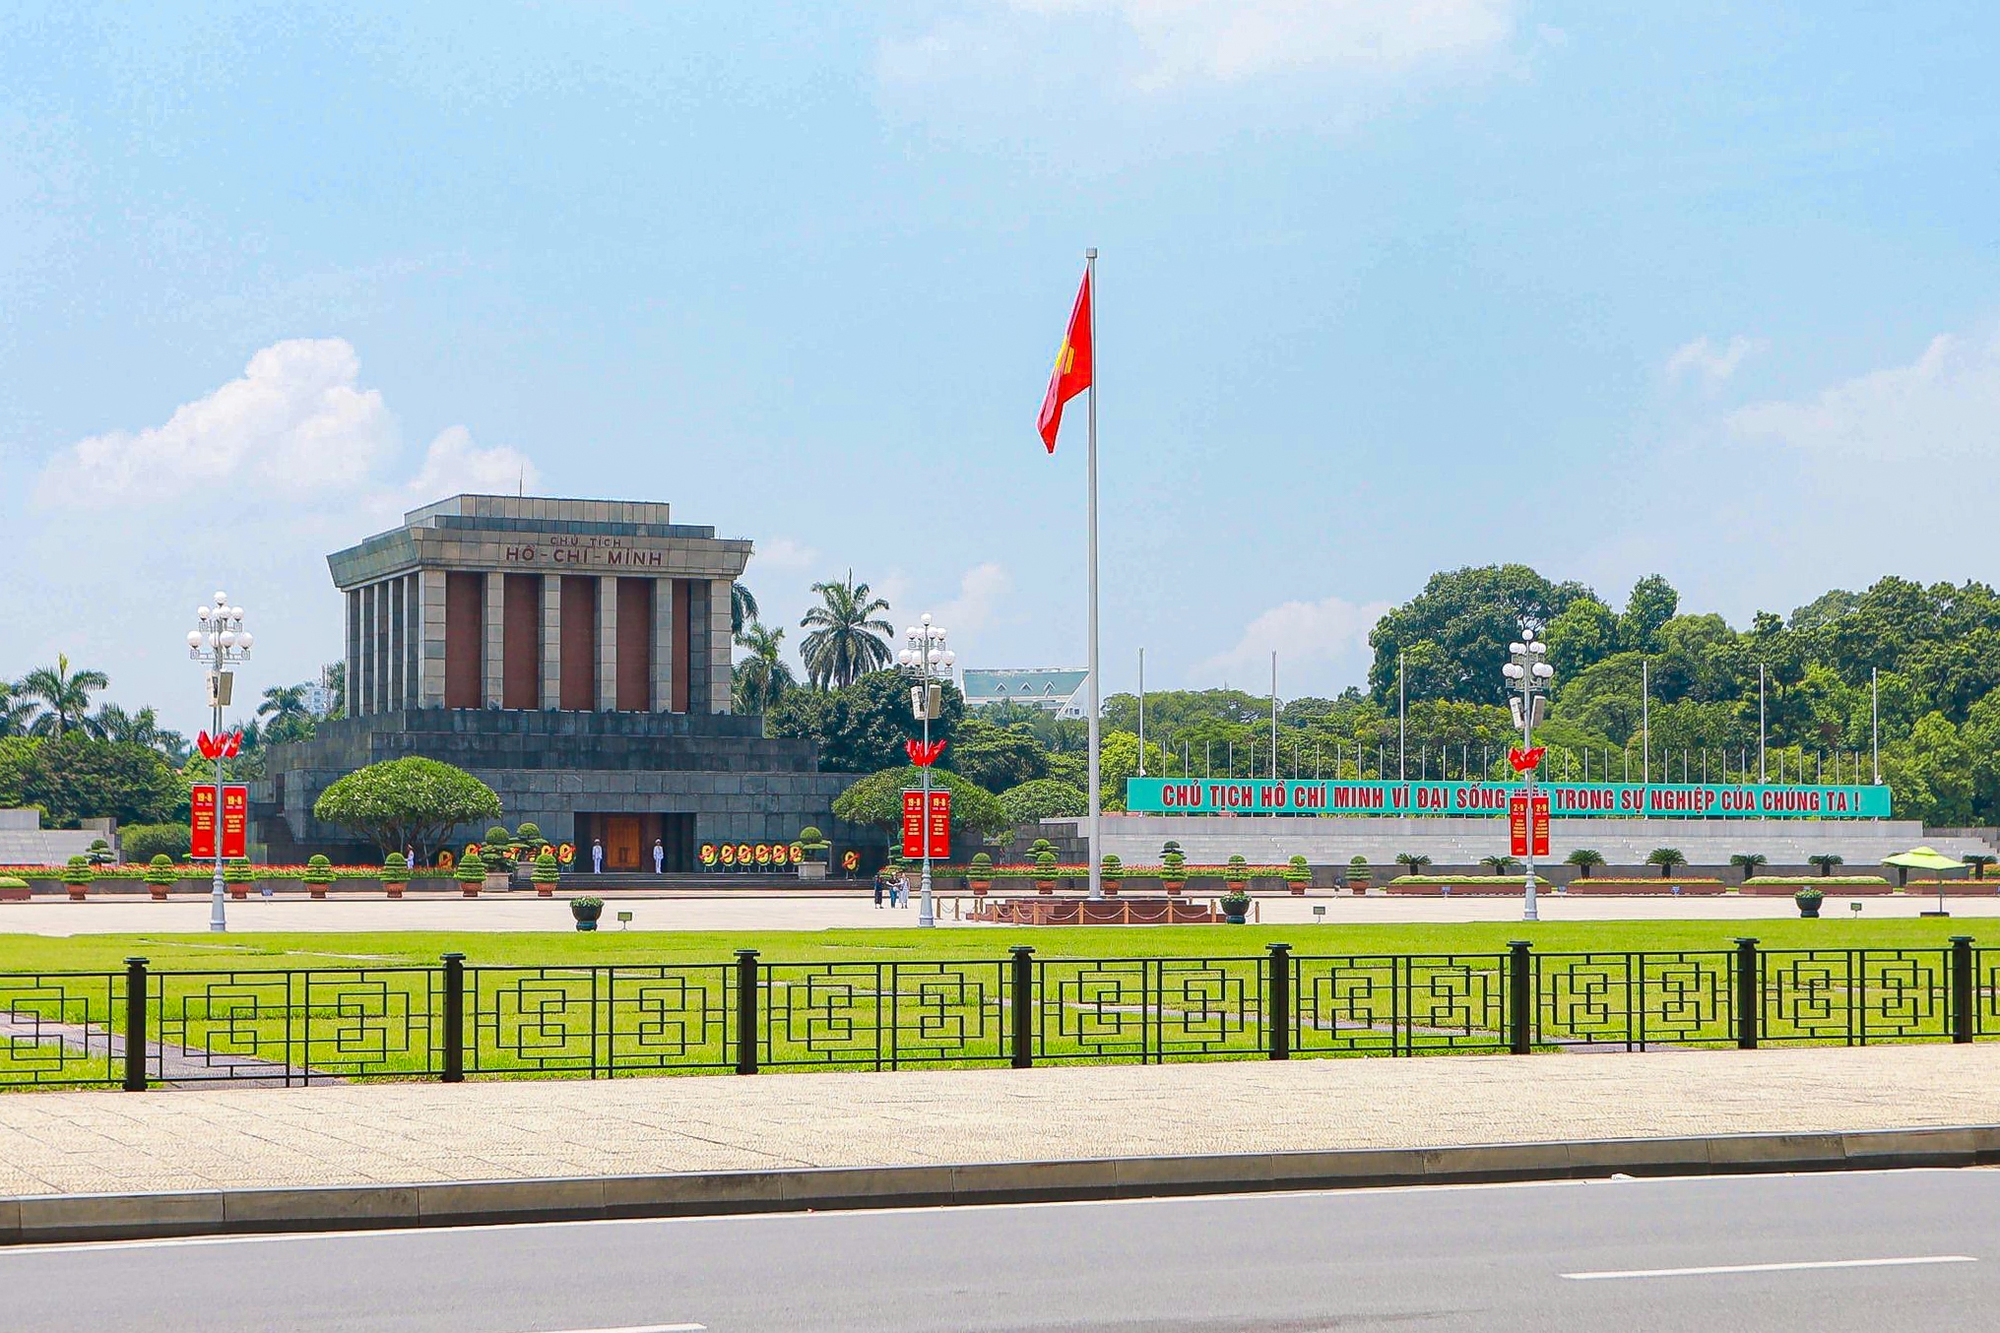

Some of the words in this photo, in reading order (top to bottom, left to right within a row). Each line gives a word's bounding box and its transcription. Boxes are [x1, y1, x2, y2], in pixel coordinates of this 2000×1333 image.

[1162, 779, 1201, 806] CHỦ
[1210, 785, 1252, 810] TỊCH
[1261, 780, 1286, 807] HỒ
[1294, 782, 1326, 808] CHÍ
[1334, 786, 1384, 808] MINH
[1391, 783, 1410, 809] VĨ
[1416, 787, 1448, 812] ĐẠI
[1456, 782, 1505, 809] SỐNG
[1555, 789, 1614, 810] TRONG
[1621, 787, 1645, 813] SỰ
[1651, 786, 1715, 814] NGHIỆP
[1721, 785, 1756, 811] CỦA
[1762, 786, 1820, 811] CHÚNG
[1826, 791, 1848, 811] TA
